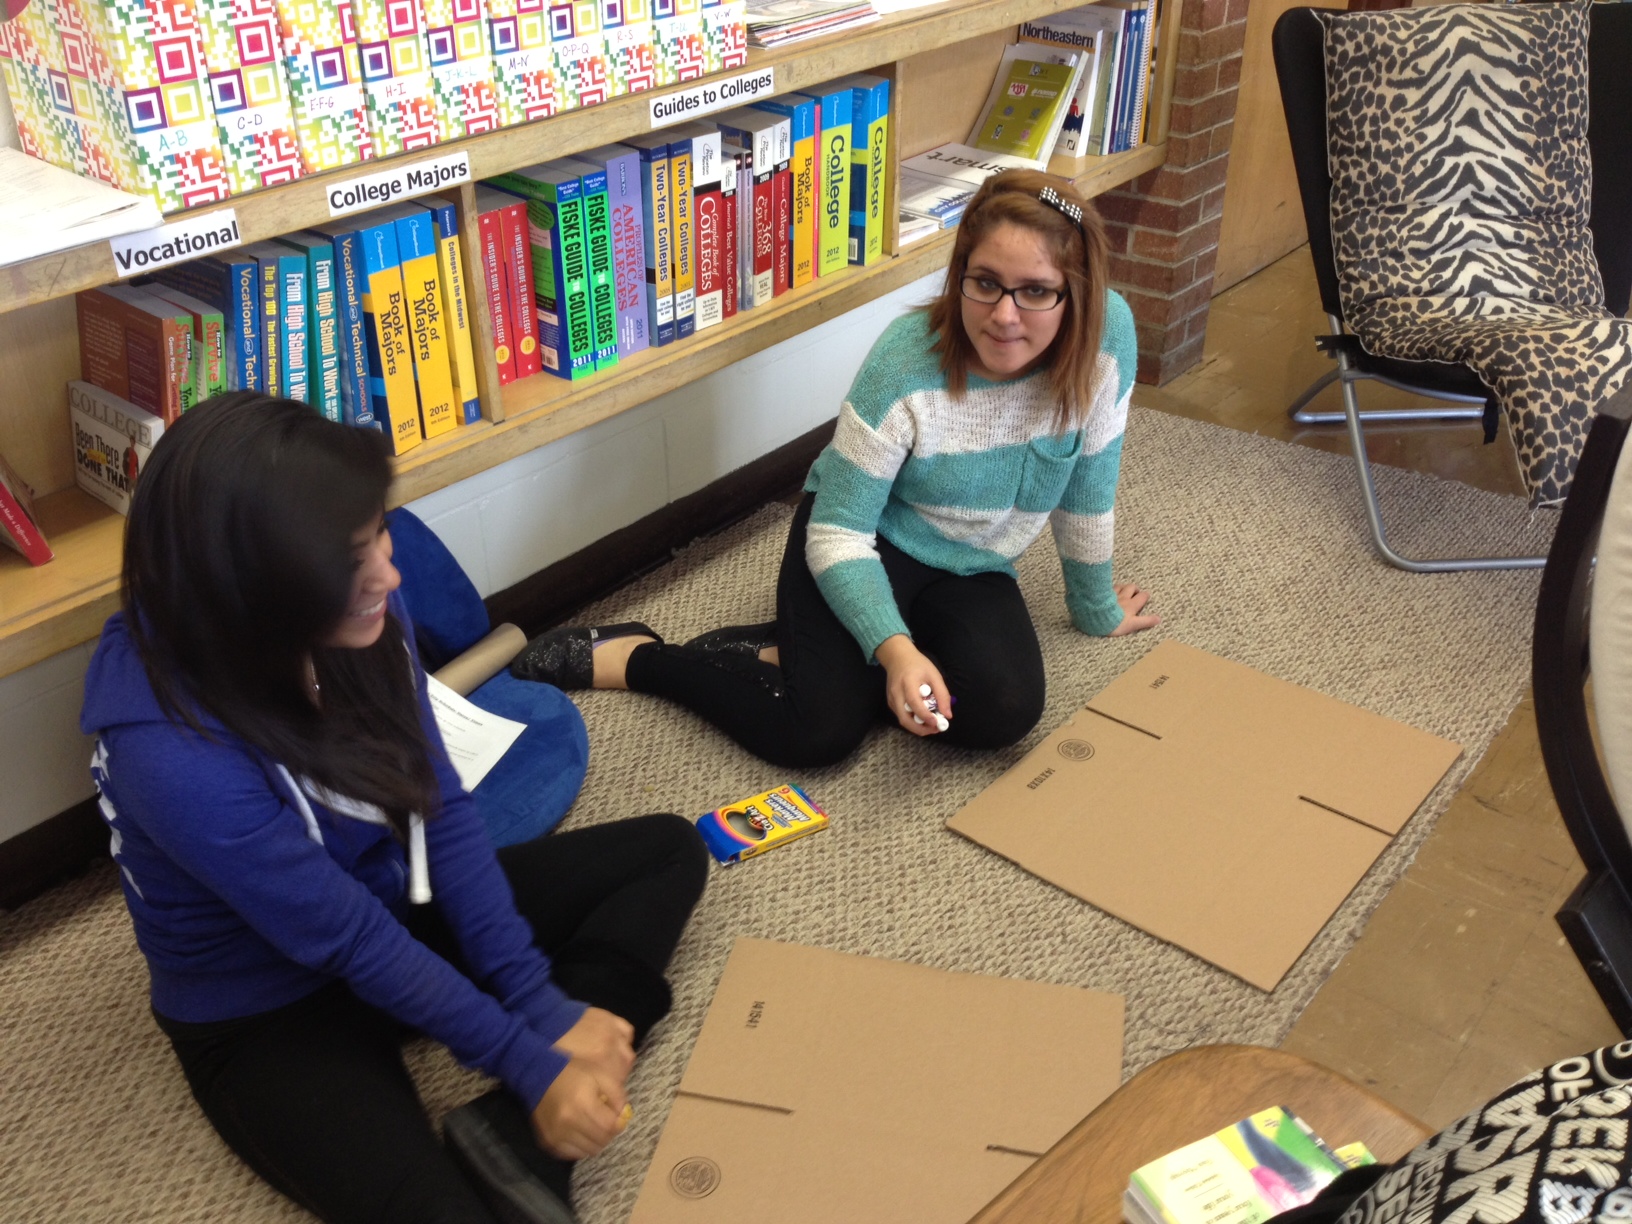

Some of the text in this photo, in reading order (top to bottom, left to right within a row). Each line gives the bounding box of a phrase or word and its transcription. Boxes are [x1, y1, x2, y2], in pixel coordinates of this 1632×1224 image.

[562, 43, 590, 57] O-P-Q
[616, 29, 634, 43] R-S
[1022, 22, 1094, 48] Northeastern
[443, 67, 478, 82] J-K-L
[508, 55, 530, 71] M-N
[309, 96, 335, 112] E-F-G
[385, 84, 407, 97] H-I
[652, 70, 772, 120] Guides to Colleges
[237, 114, 263, 130] C-D
[158, 130, 188, 151] A-B
[329, 160, 468, 211] College Majors
[676, 159, 687, 218] Two-Year
[804, 156, 813, 207] Book of
[827, 134, 845, 229] College
[871, 126, 884, 219] College
[655, 164, 667, 224] Two-Year
[797, 173, 805, 225] Majors
[561, 200, 580, 242] FISKE
[587, 194, 605, 234] FISKE
[756, 195, 765, 258] COLLEGES
[779, 199, 787, 242] College
[114, 220, 240, 271] Vocational
[515, 234, 525, 264] INSIDER'S
[590, 235, 609, 275] GUIDE
[622, 203, 639, 307] AMERICAN
[634, 224, 643, 281] PROFILES OF
[657, 227, 669, 282] Colleges
[679, 222, 689, 276] Colleges
[700, 196, 716, 291] COLLEGES
[762, 221, 772, 255] 368
[826, 246, 840, 258] 2012
[342, 237, 359, 308] Vocational
[487, 242, 498, 272] INSIDER'S
[563, 245, 584, 283] GUIDE
[612, 207, 627, 312] COLLEGES
[712, 266, 720, 276] of
[797, 259, 810, 271] 2012
[264, 265, 277, 316] The Top 100
[285, 272, 304, 303] From
[316, 260, 331, 290] From
[448, 241, 465, 330] Colleges in the Midwest
[490, 273, 500, 292] GUIDE
[518, 265, 527, 284] GUIDE
[519, 285, 528, 293] TO
[240, 268, 254, 354] Vocational and
[316, 290, 334, 317] High
[424, 278, 441, 342] Book of
[492, 293, 501, 302] TO
[493, 303, 503, 315] THE
[520, 294, 529, 306] THE
[726, 277, 734, 312] Colleges
[267, 320, 275, 333] The
[285, 302, 305, 330] High
[389, 291, 406, 356] Book of
[413, 298, 431, 362] Majors
[495, 316, 506, 344] COLLEGES
[522, 306, 532, 335] COLLEGES
[567, 291, 590, 354] COLLEGES
[594, 283, 614, 346] COLLEGES
[175, 323, 190, 385] Survive
[206, 322, 221, 382] Survive
[217, 350, 222, 358] to
[267, 333, 277, 358] Fastest
[287, 330, 305, 370] School
[318, 318, 336, 357] School
[350, 321, 366, 379] Technical
[380, 312, 396, 377] Majors
[597, 345, 616, 359] 2011
[187, 351, 192, 360] to
[267, 358, 278, 385] Growing
[321, 356, 338, 369] To
[572, 354, 592, 368] 2011
[289, 370, 306, 383] To
[322, 369, 340, 400] Work
[358, 378, 367, 413] SCHOOLS
[429, 403, 449, 418] 2012
[70, 386, 150, 445] COLLEGE
[397, 418, 415, 434] 2012
[74, 421, 121, 470] Been There
[76, 449, 103, 480] DONE
[105, 465, 130, 494] THAT
[764, 797, 797, 821] Markers
[767, 791, 812, 823] Marqueurs
